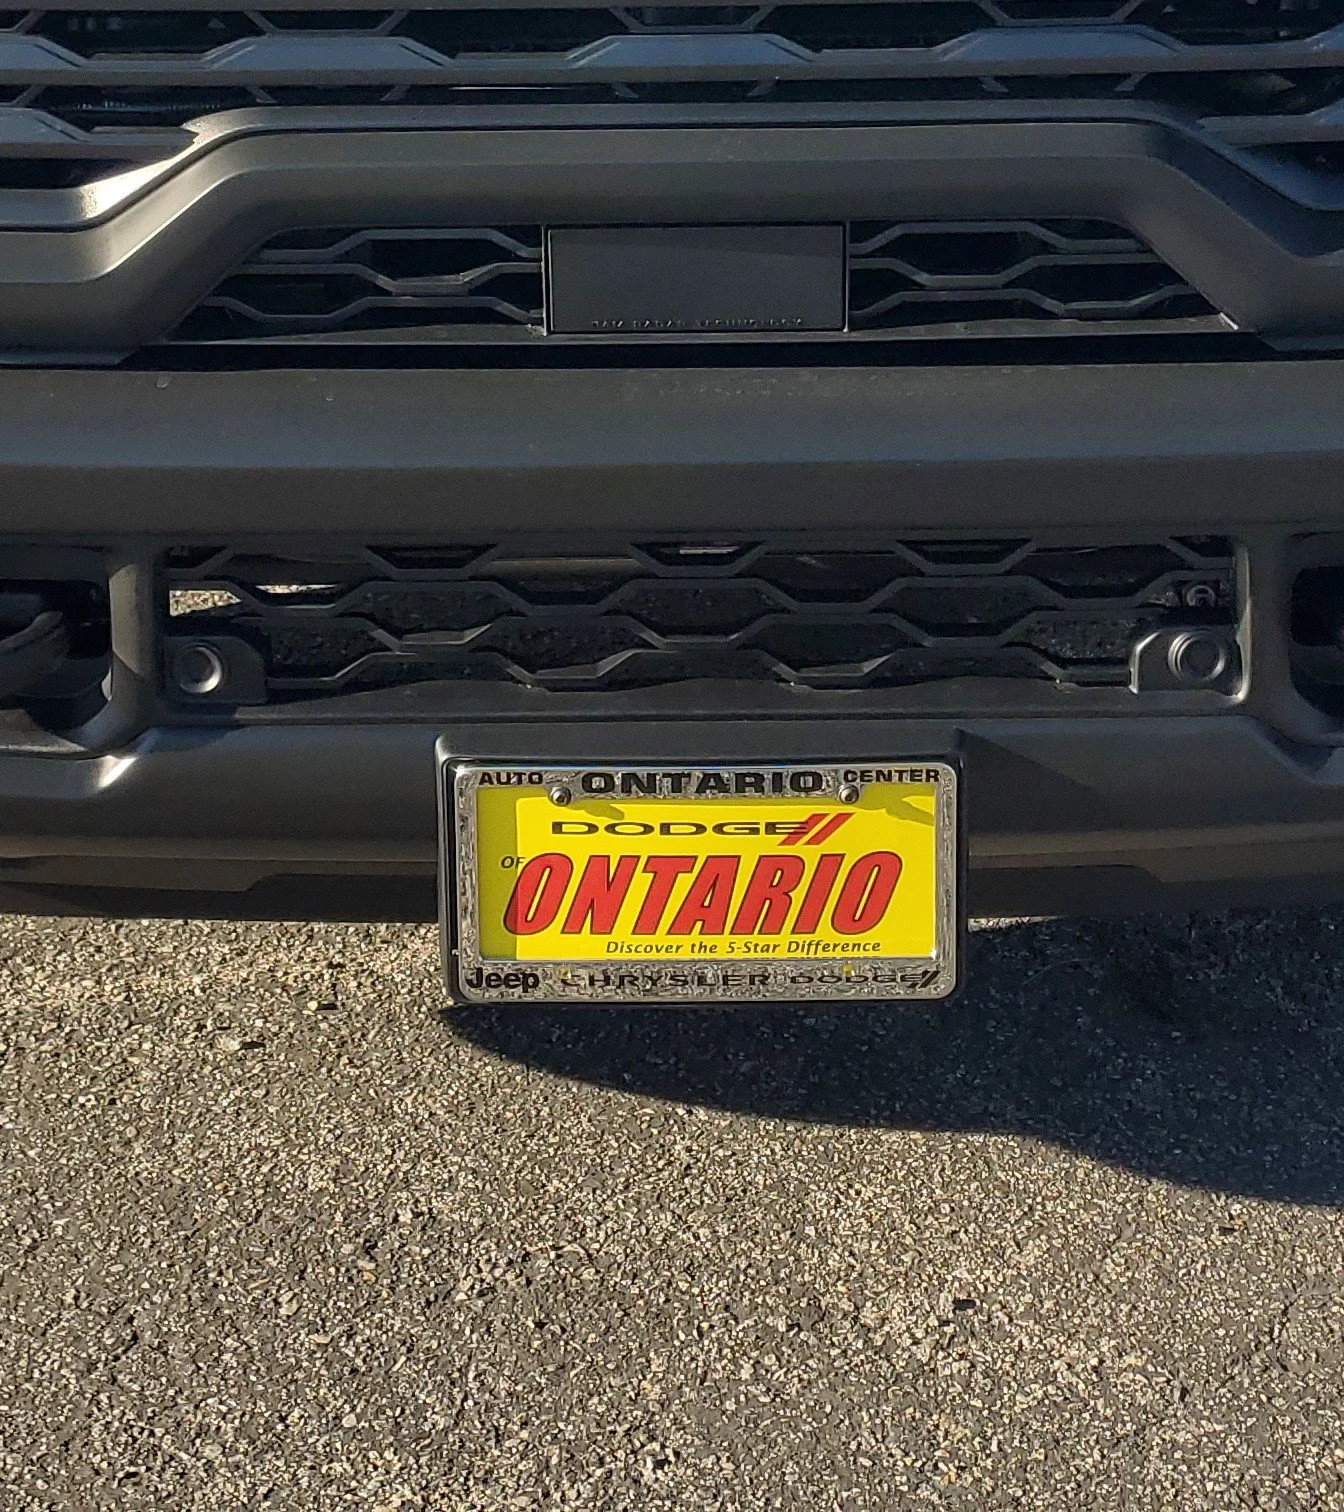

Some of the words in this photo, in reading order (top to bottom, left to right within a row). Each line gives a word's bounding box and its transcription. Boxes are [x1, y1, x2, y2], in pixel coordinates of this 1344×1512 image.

[478, 771, 544, 786] AUTO
[581, 771, 824, 794] ONTARIO
[843, 768, 941, 784] CENTER
[551, 820, 809, 837] DODGE
[501, 856, 526, 869] OF
[502, 850, 904, 937] ONTARIO
[605, 940, 683, 955] Discover
[690, 940, 718, 954] the
[726, 940, 781, 955] 5-Star
[786, 938, 881, 956] Difference
[465, 966, 541, 994] Jeep
[560, 972, 770, 990] CHRYSLER
[789, 973, 922, 985] DODGE
